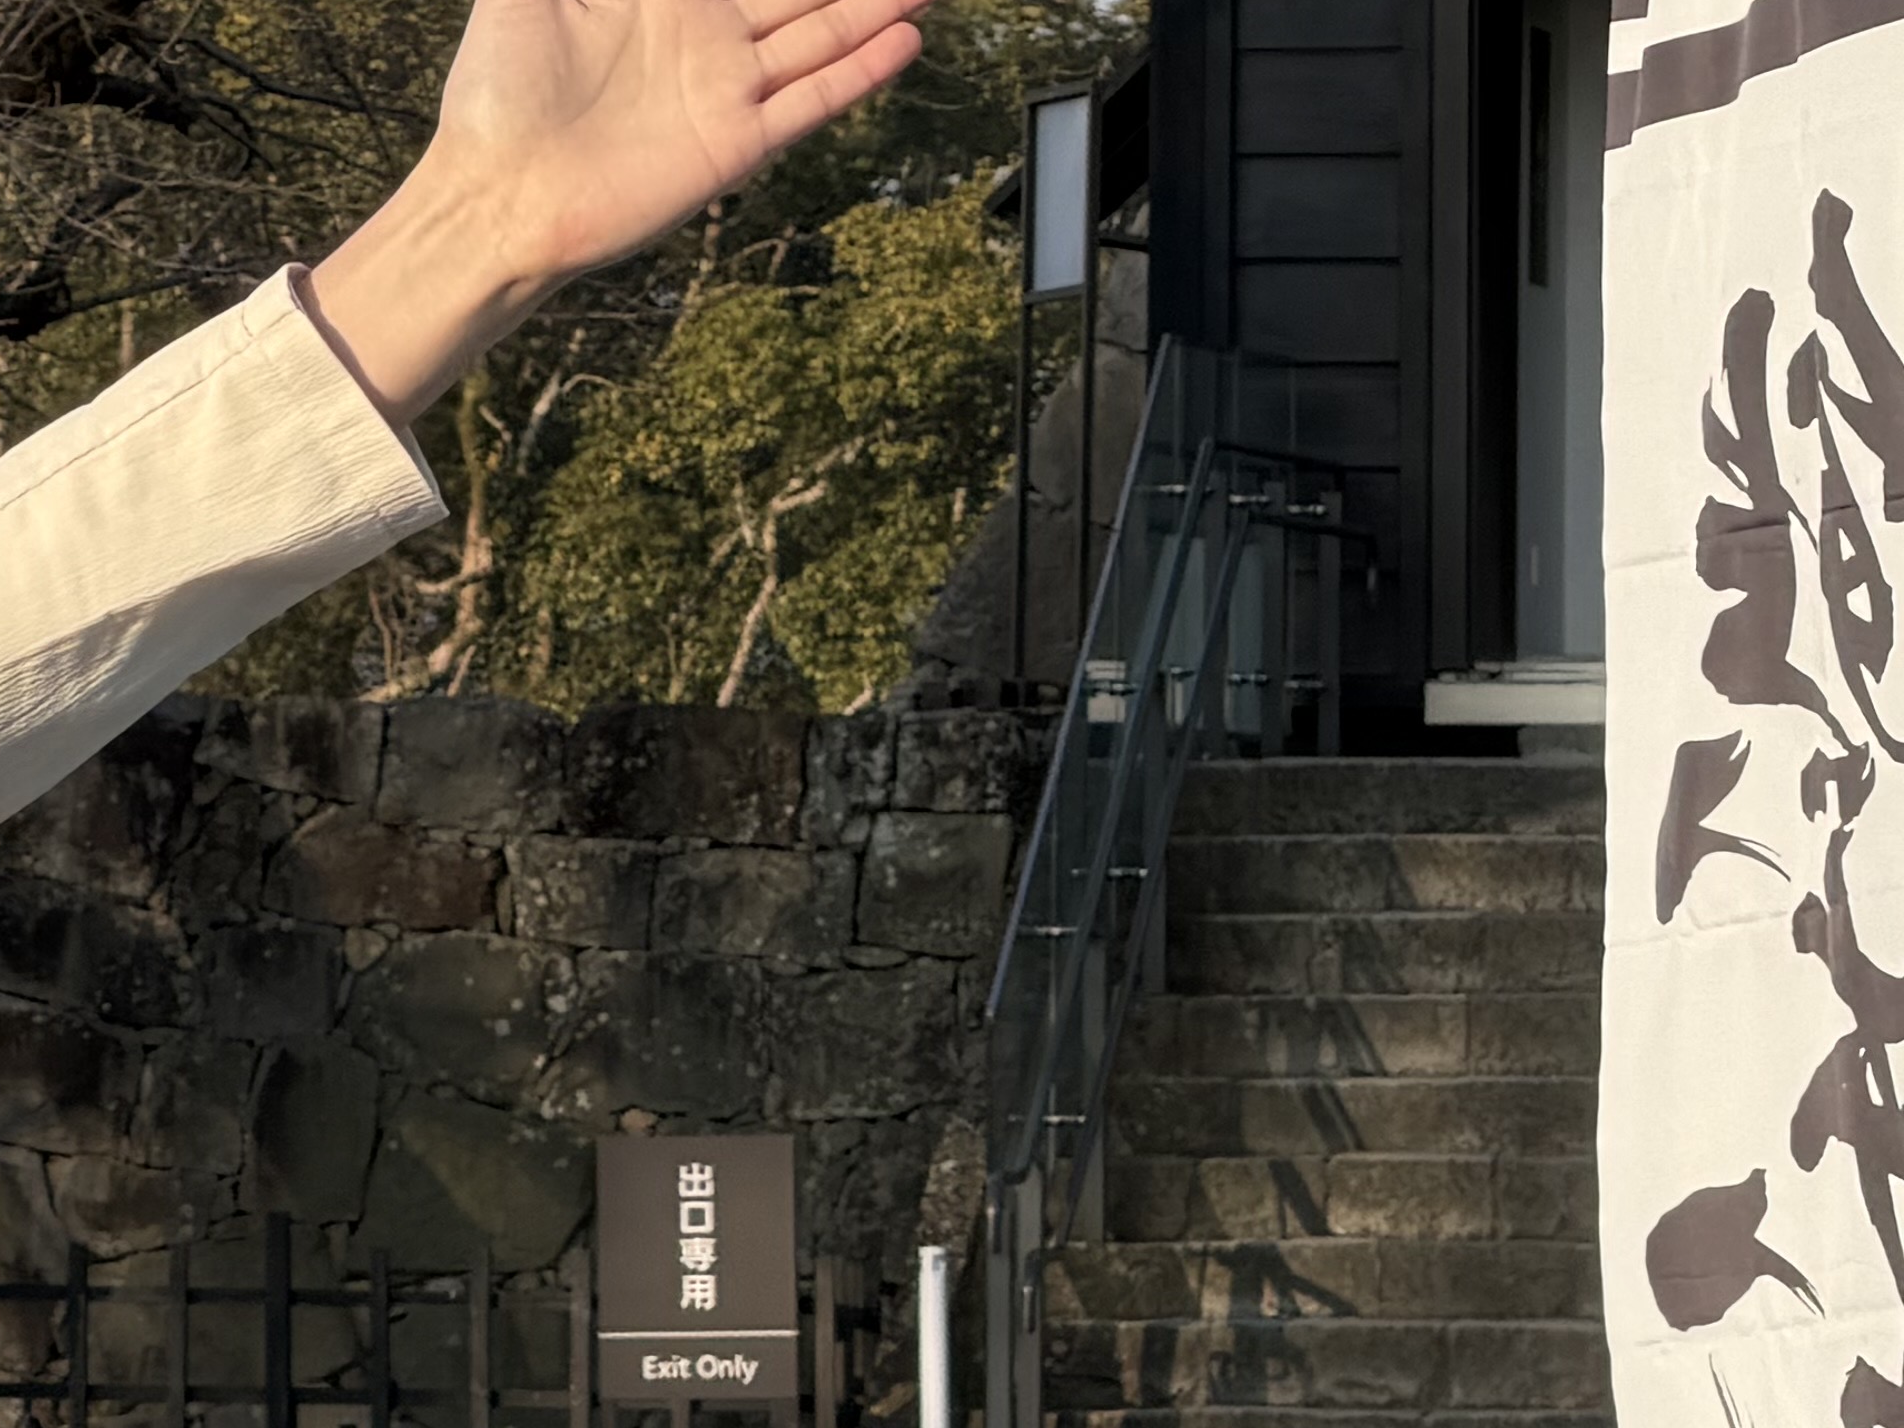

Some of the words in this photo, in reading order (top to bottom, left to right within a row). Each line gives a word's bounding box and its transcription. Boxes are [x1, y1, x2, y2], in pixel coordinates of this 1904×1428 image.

[679, 1162, 717, 1311] 出口専用
[642, 1355, 691, 1381] Exit
[696, 1354, 758, 1385] Only
